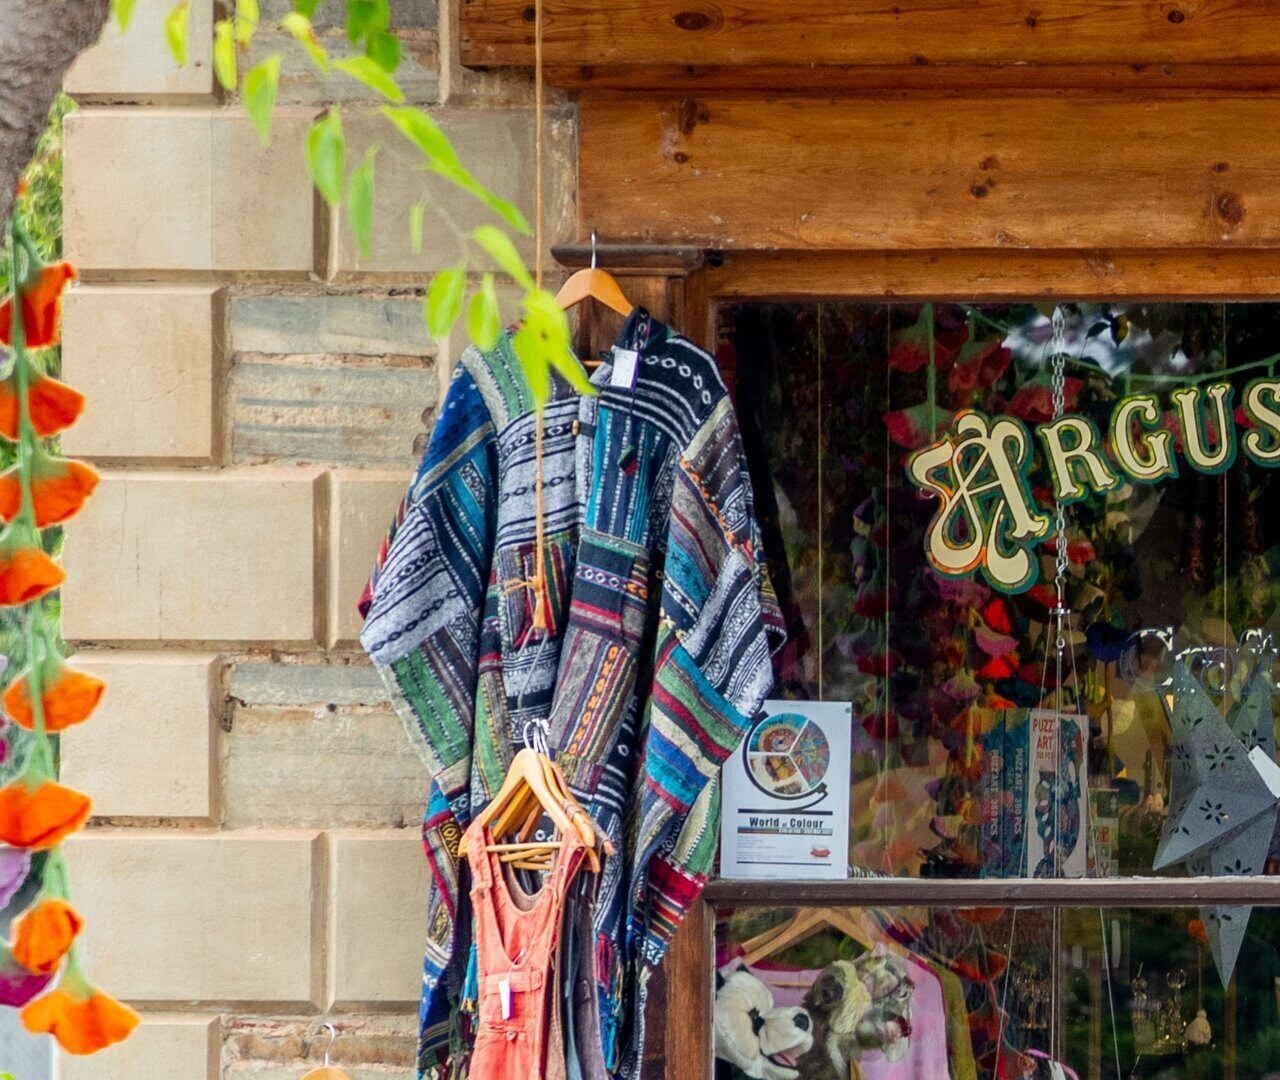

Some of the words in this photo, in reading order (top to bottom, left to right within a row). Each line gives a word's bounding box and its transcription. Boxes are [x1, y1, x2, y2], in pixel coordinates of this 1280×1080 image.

[1037, 736, 1053, 749] ART
[750, 817, 779, 827] World
[790, 818, 824, 828] Colour
